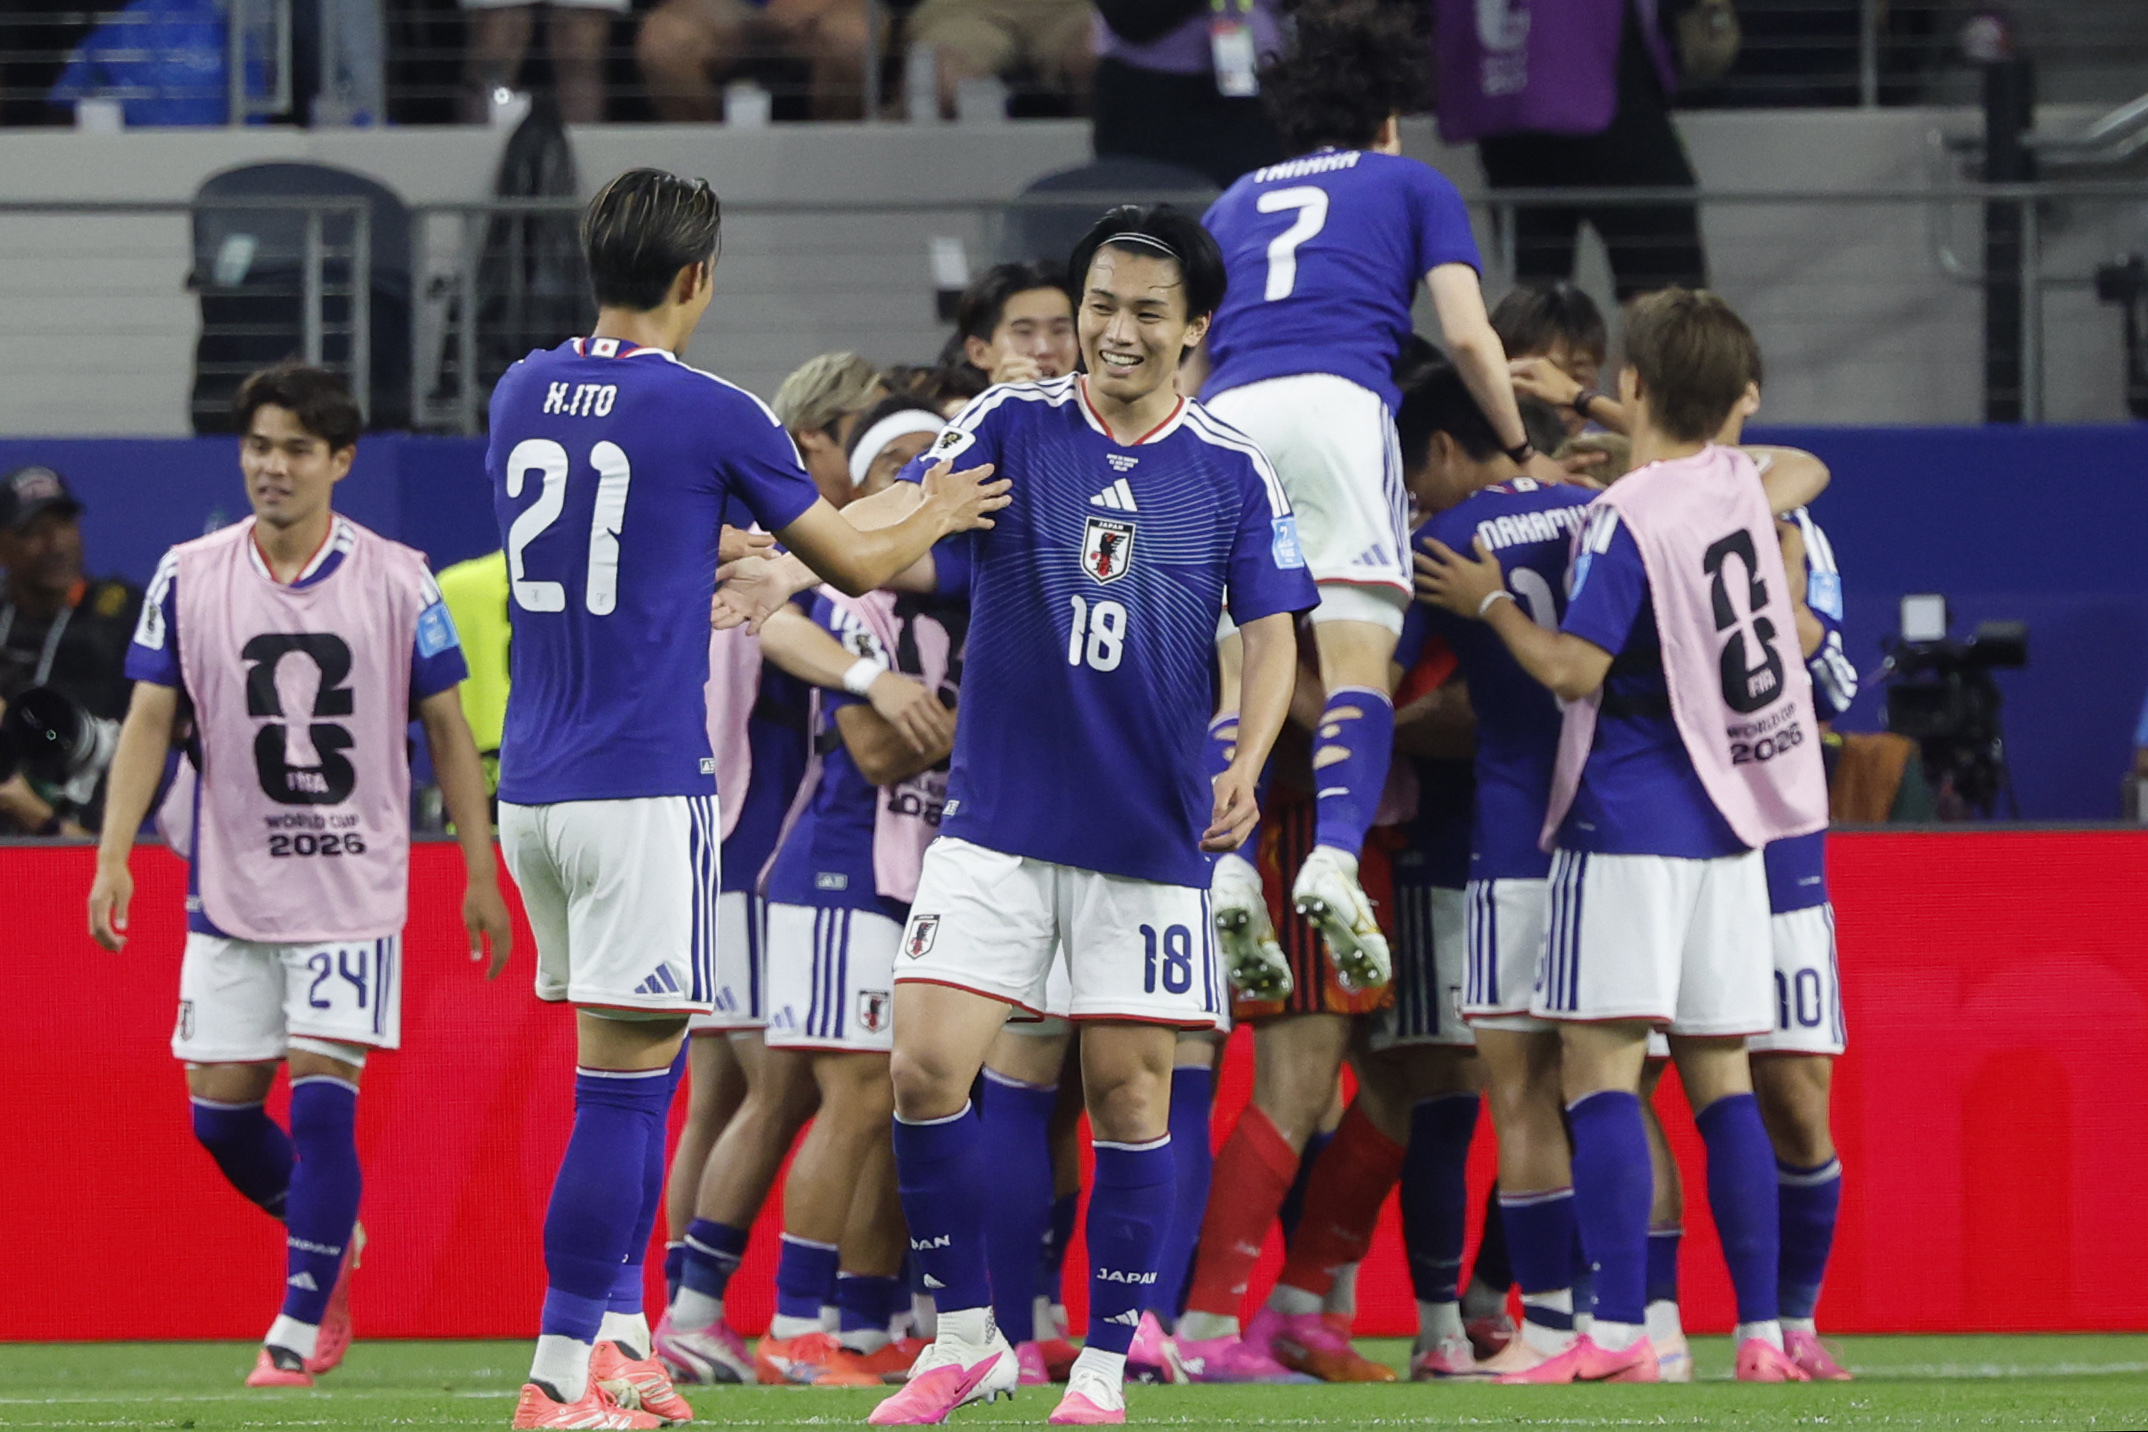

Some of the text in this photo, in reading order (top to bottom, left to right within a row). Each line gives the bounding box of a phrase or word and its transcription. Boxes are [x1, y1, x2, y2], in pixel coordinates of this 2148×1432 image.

[1256, 185, 1329, 302] 7
[543, 381, 618, 417] H.ITO
[507, 438, 632, 616] 21
[1098, 521, 1125, 531] JAPAN
[1068, 594, 1127, 672] 18
[1727, 712, 1780, 739] WORLD
[1730, 722, 1804, 766] 2026
[264, 812, 326, 830] WORLD
[268, 833, 367, 857] 2026
[308, 950, 367, 1008] 24
[1139, 924, 1192, 994] 18
[1096, 1267, 1158, 1285] JAPAN
